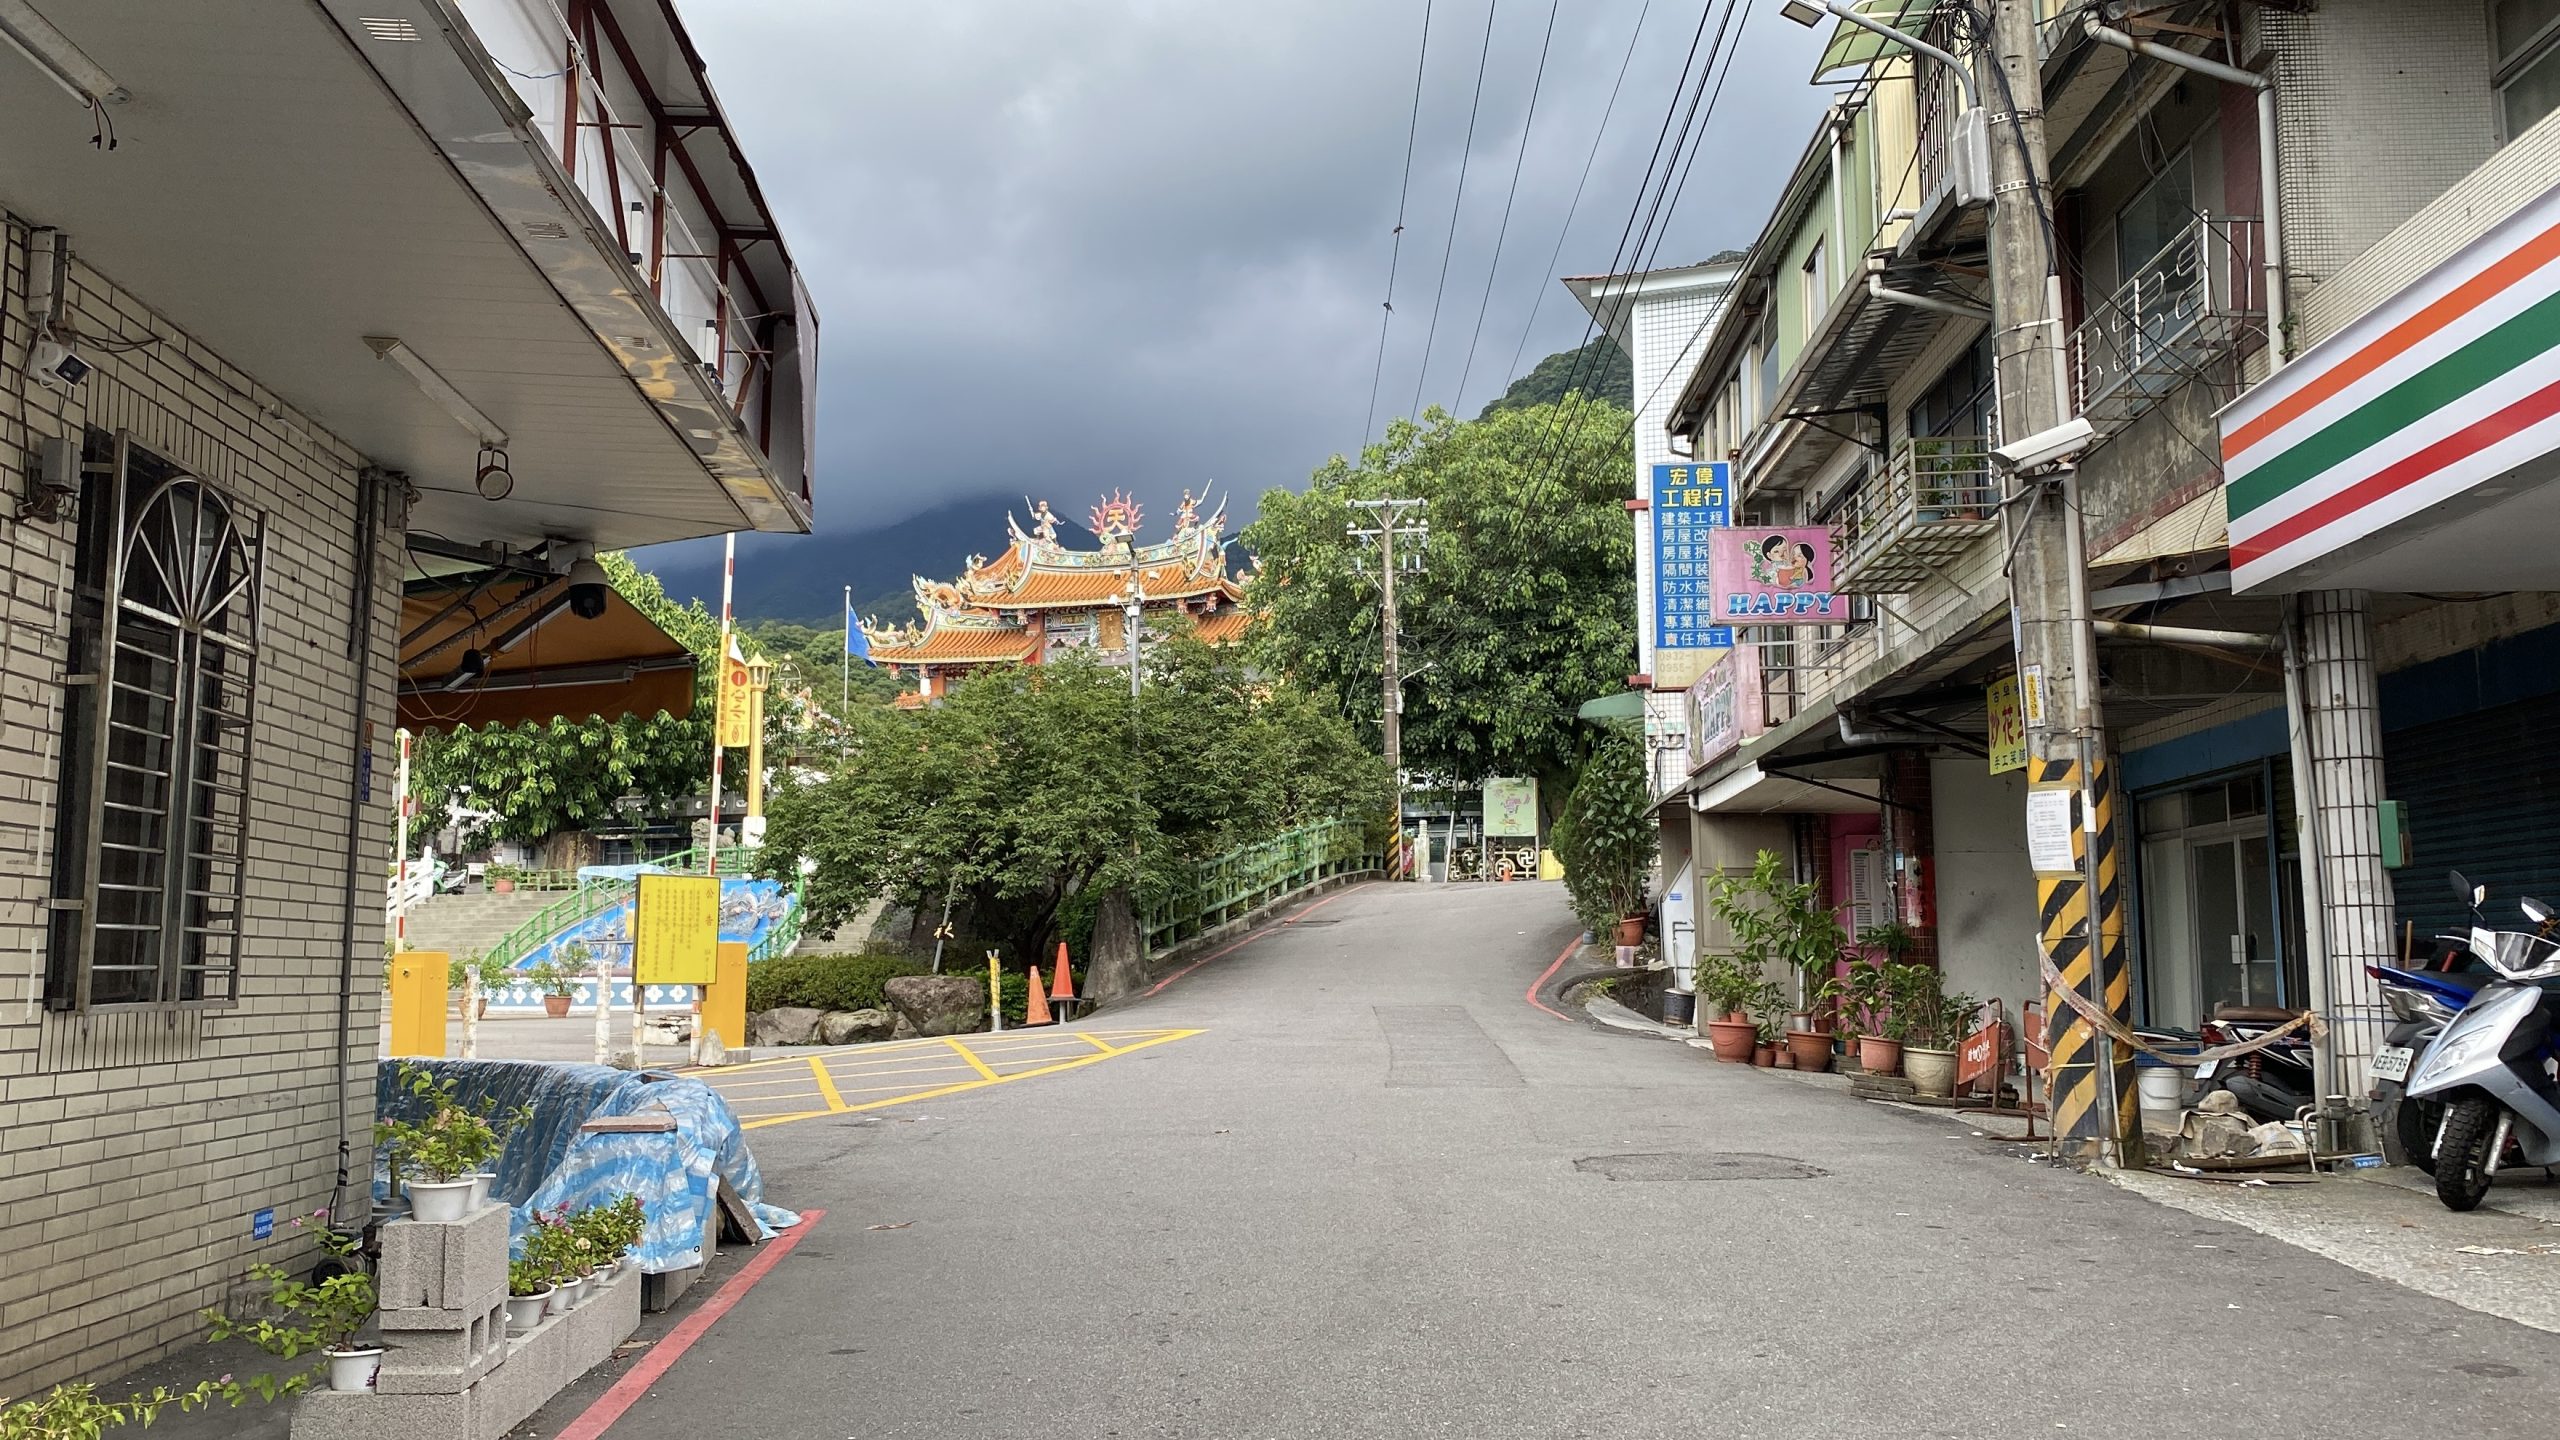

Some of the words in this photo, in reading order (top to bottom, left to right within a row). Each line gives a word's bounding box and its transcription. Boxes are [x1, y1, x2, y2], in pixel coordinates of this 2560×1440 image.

[1669, 467, 1714, 486] 宏偉
[1661, 488, 1723, 508] 工程行
[1661, 511, 1724, 526] 建築工程
[1727, 592, 1836, 616] HAPPY
[1665, 632, 1727, 647] 責任施工
